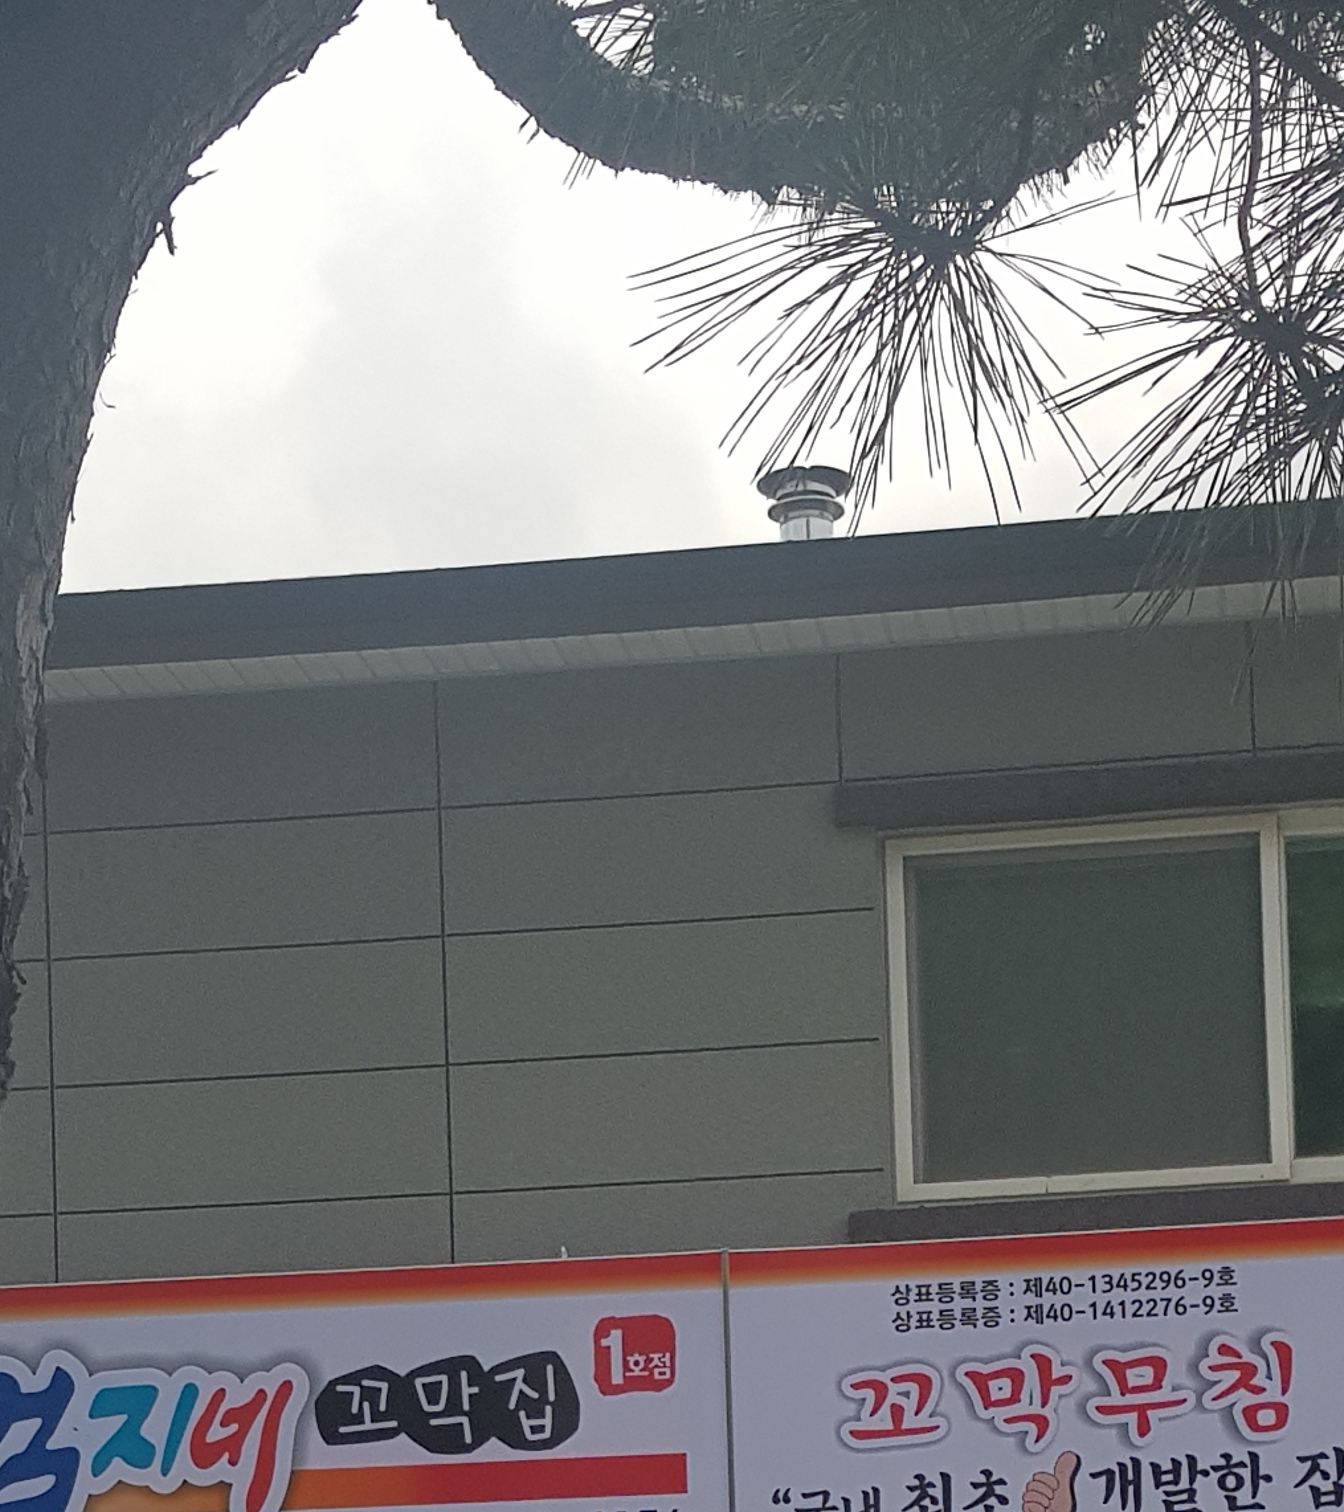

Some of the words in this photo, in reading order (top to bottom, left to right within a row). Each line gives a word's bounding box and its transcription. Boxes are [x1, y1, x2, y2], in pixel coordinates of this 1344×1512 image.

[891, 1280, 1001, 1306] 상표등록증
[1023, 1266, 1238, 1298] 제40-1345296-9호
[892, 1306, 1002, 1333] 상표등록증
[1023, 1293, 1238, 1325] 제40-1412276-9호
[600, 1329, 672, 1386] 1호점
[336, 1362, 554, 1443] 꼬막집
[848, 1339, 1293, 1443] 꼬막무침
